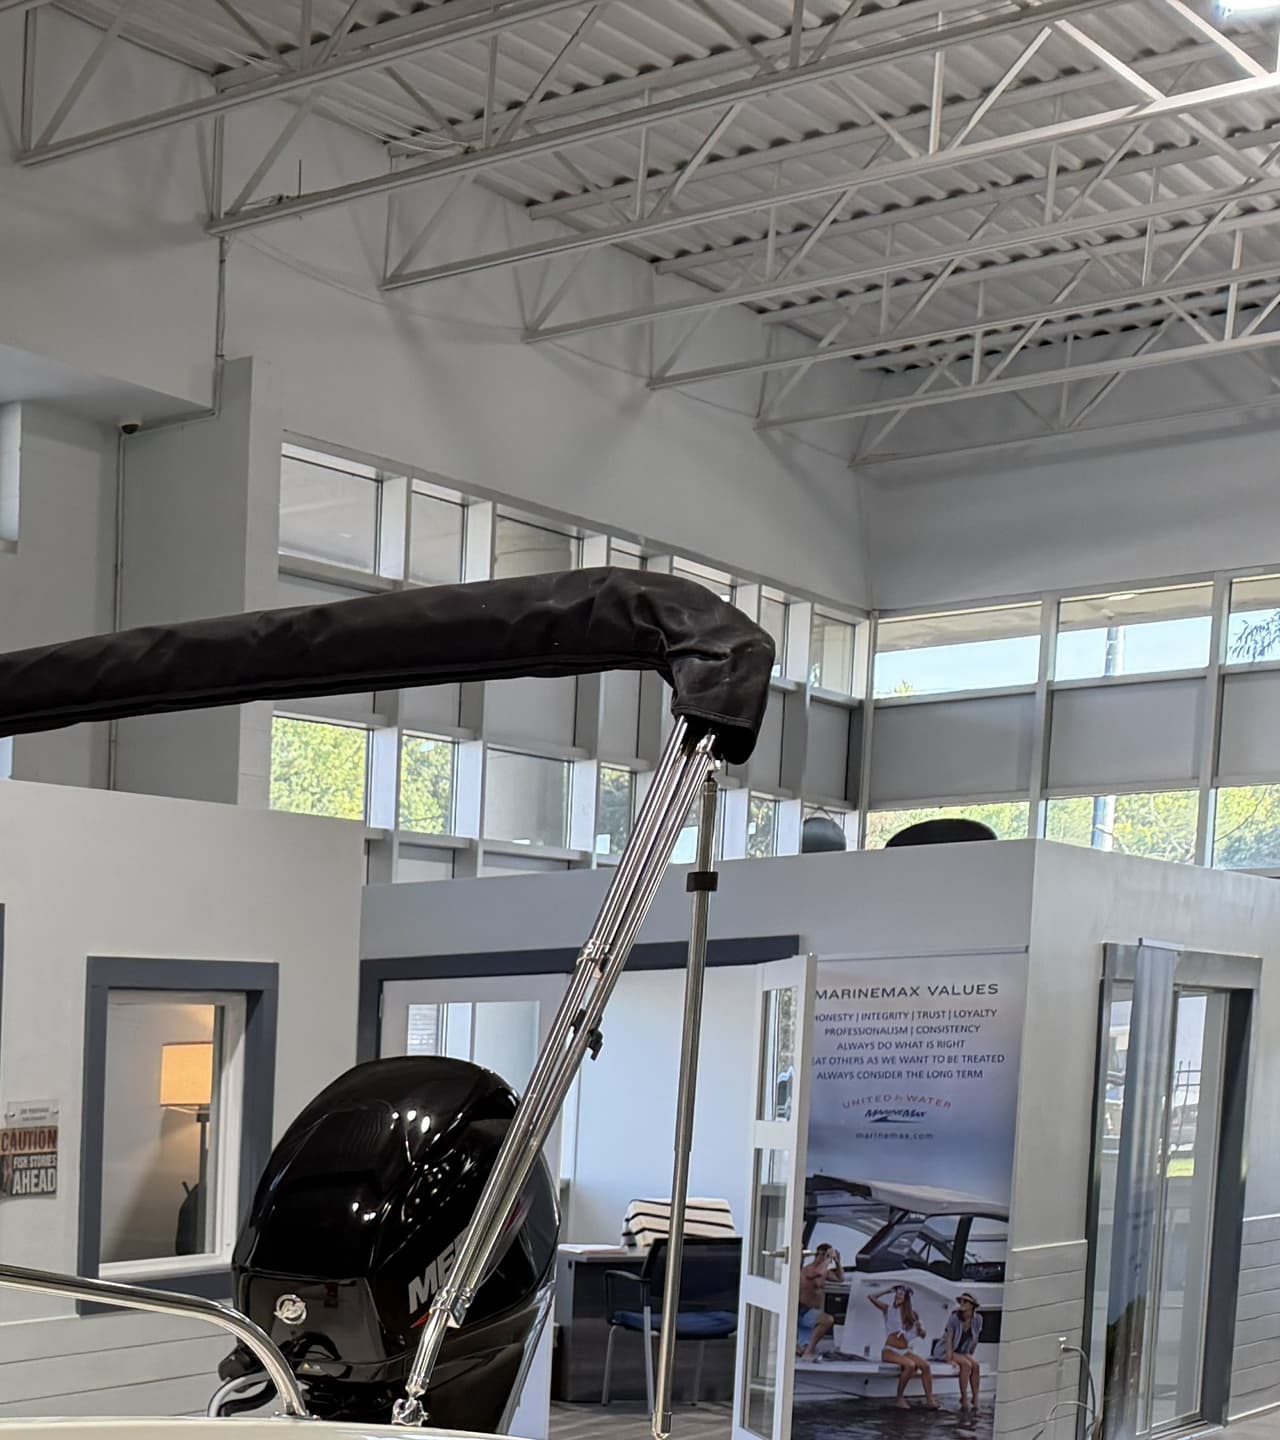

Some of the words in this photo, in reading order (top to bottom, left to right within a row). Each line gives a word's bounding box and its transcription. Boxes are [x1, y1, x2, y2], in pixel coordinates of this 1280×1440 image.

[815, 985, 920, 1000] MARINEMAX
[928, 983, 999, 996] VALUES
[861, 1011, 909, 1021] INTEGRITY
[917, 1010, 946, 1019] TRUST
[953, 1008, 997, 1018] LOYALTY
[824, 1026, 908, 1036] PROFESSIONALISM
[916, 1024, 981, 1035] CONSISTENCY
[836, 1041, 875, 1051] ALWAYS
[878, 1041, 892, 1050] DO
[895, 1040, 923, 1049] WHAT
[926, 1040, 934, 1049] IS
[937, 1039, 965, 1048] RIGHT
[829, 1055, 865, 1065] OTHERS
[866, 1055, 879, 1065] AS
[881, 1055, 896, 1065] WE
[899, 1055, 929, 1064] WANT
[932, 1054, 945, 1064] TO
[947, 1054, 959, 1063] BE
[962, 1054, 1005, 1063] TREATED
[816, 1071, 854, 1080] ALWAYS
[856, 1070, 903, 1080] CONSIDER
[906, 1069, 924, 1079] THE
[927, 1069, 953, 1079] LONG
[957, 1069, 983, 1079] TERM
[0, 1129, 57, 1152] CAUTION
[12, 1168, 57, 1195] AHEAD
